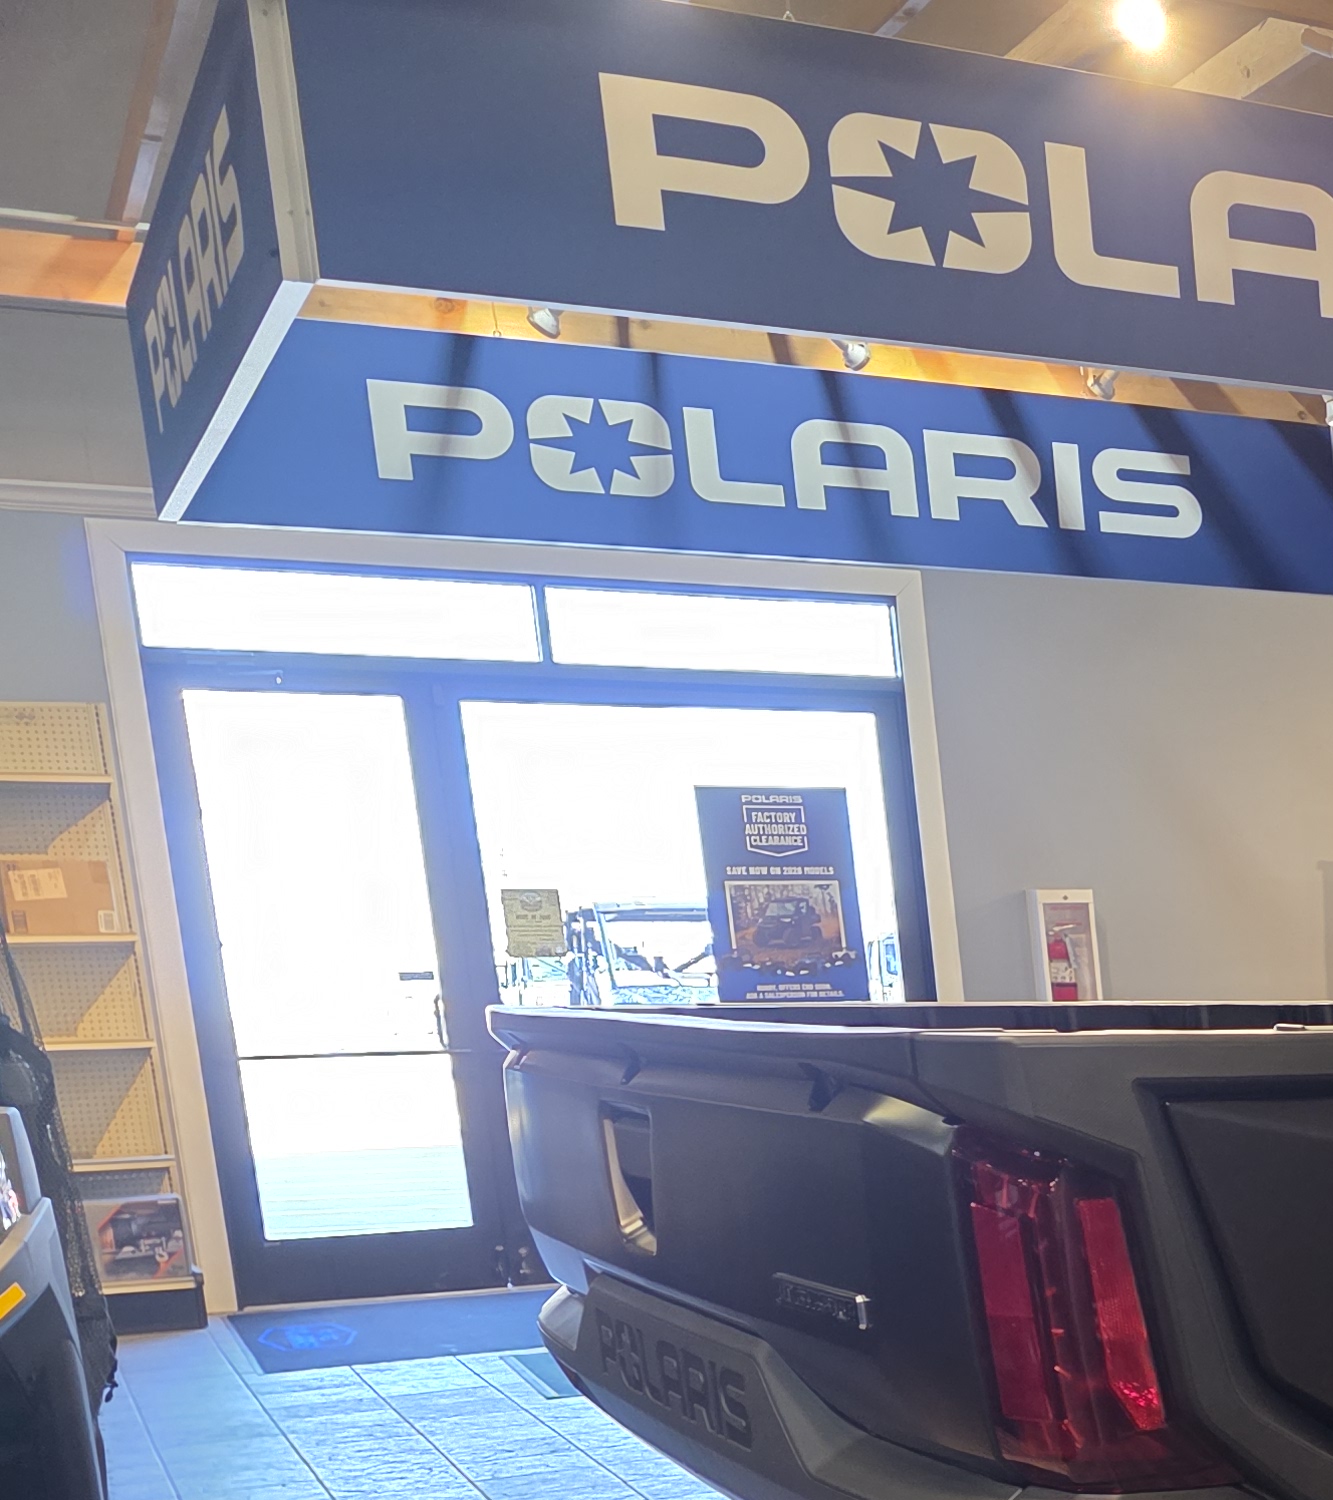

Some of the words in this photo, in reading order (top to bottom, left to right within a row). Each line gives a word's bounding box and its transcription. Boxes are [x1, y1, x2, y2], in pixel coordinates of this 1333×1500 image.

[144, 103, 245, 434] POLARIS
[366, 378, 1202, 540] POLARIS
[741, 794, 803, 803] POLARIS
[751, 811, 796, 823] FACTORY
[745, 823, 807, 835] AUTHORIZED
[750, 835, 804, 846] CLEARANCE
[726, 866, 748, 875] SAVE
[595, 1307, 753, 1452] POLARIS
